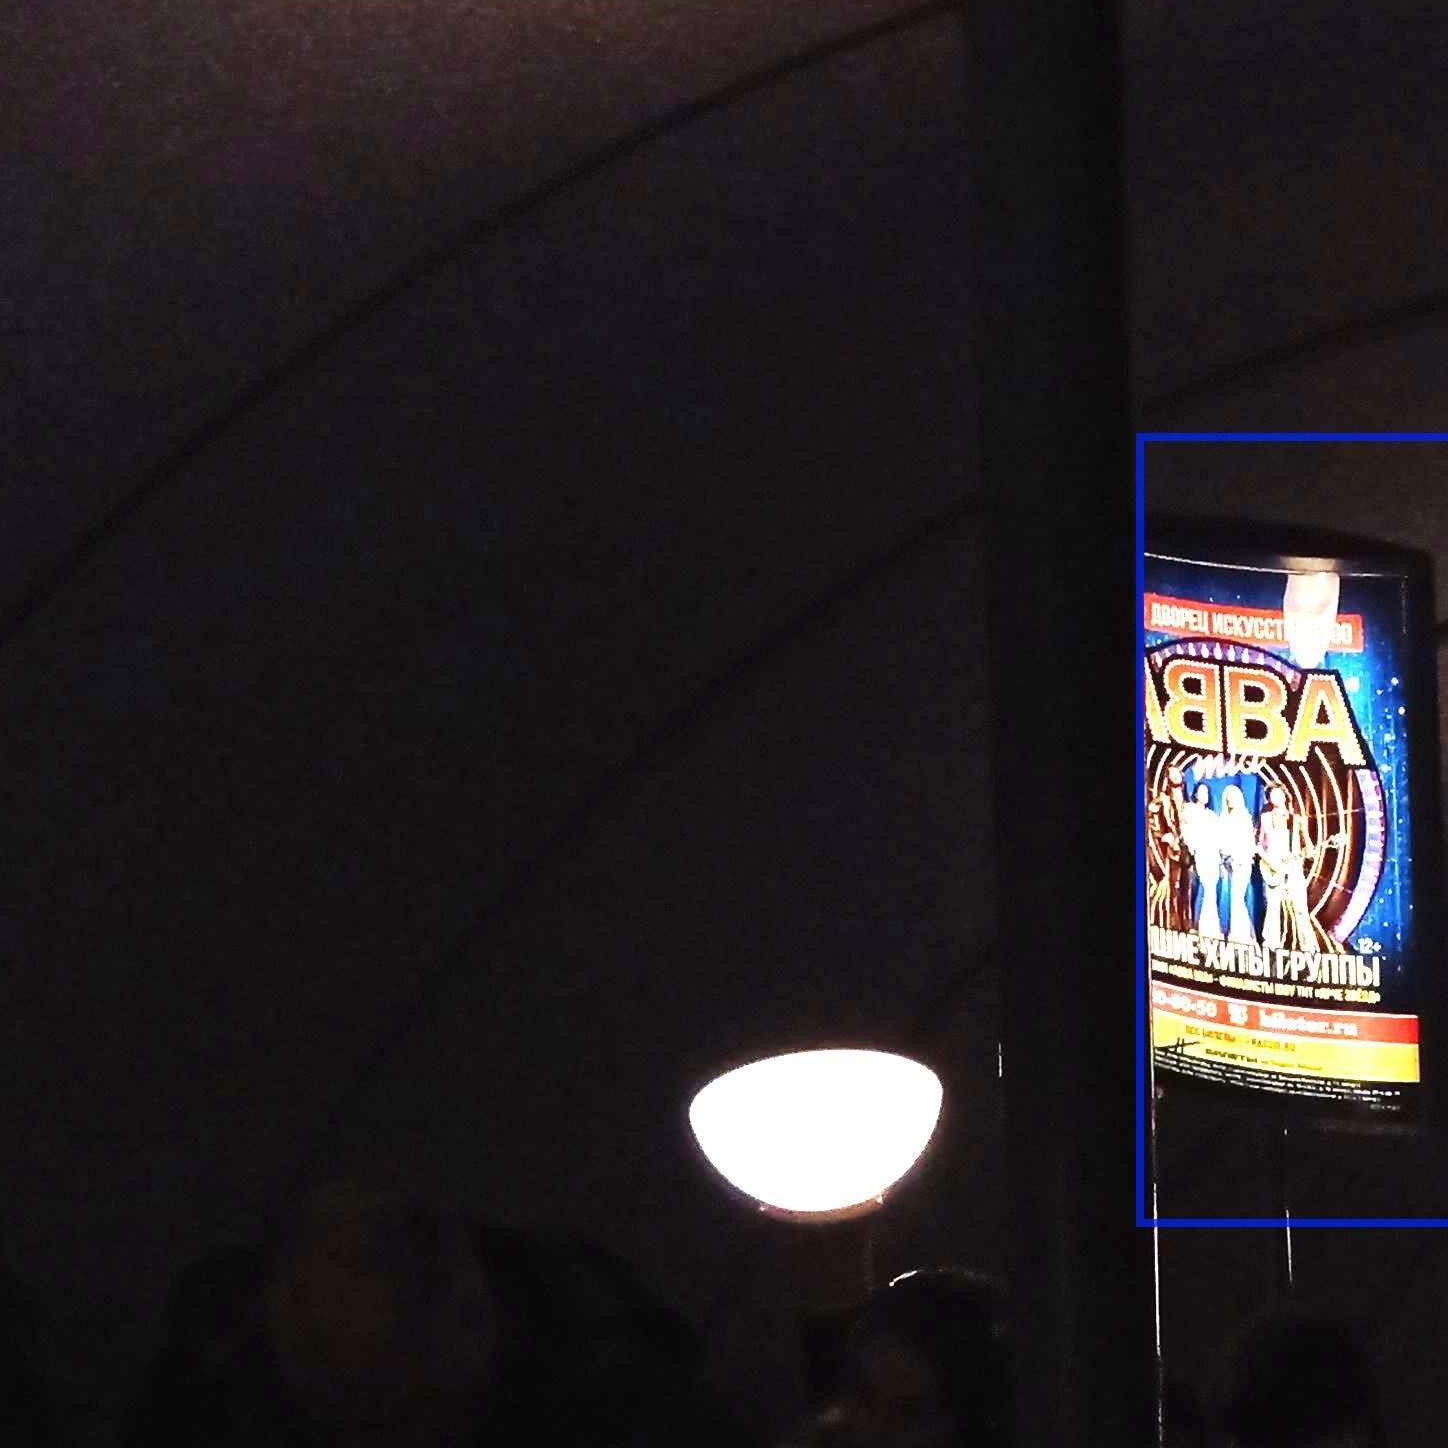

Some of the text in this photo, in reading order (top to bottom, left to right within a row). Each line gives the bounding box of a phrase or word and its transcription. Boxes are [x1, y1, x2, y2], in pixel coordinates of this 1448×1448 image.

[1152, 602, 1289, 642] ДВОРЕЦ ИСКУССТ
[1204, 938, 1271, 978] ХИТЫ
[1275, 947, 1381, 988] ГРУППЫ
